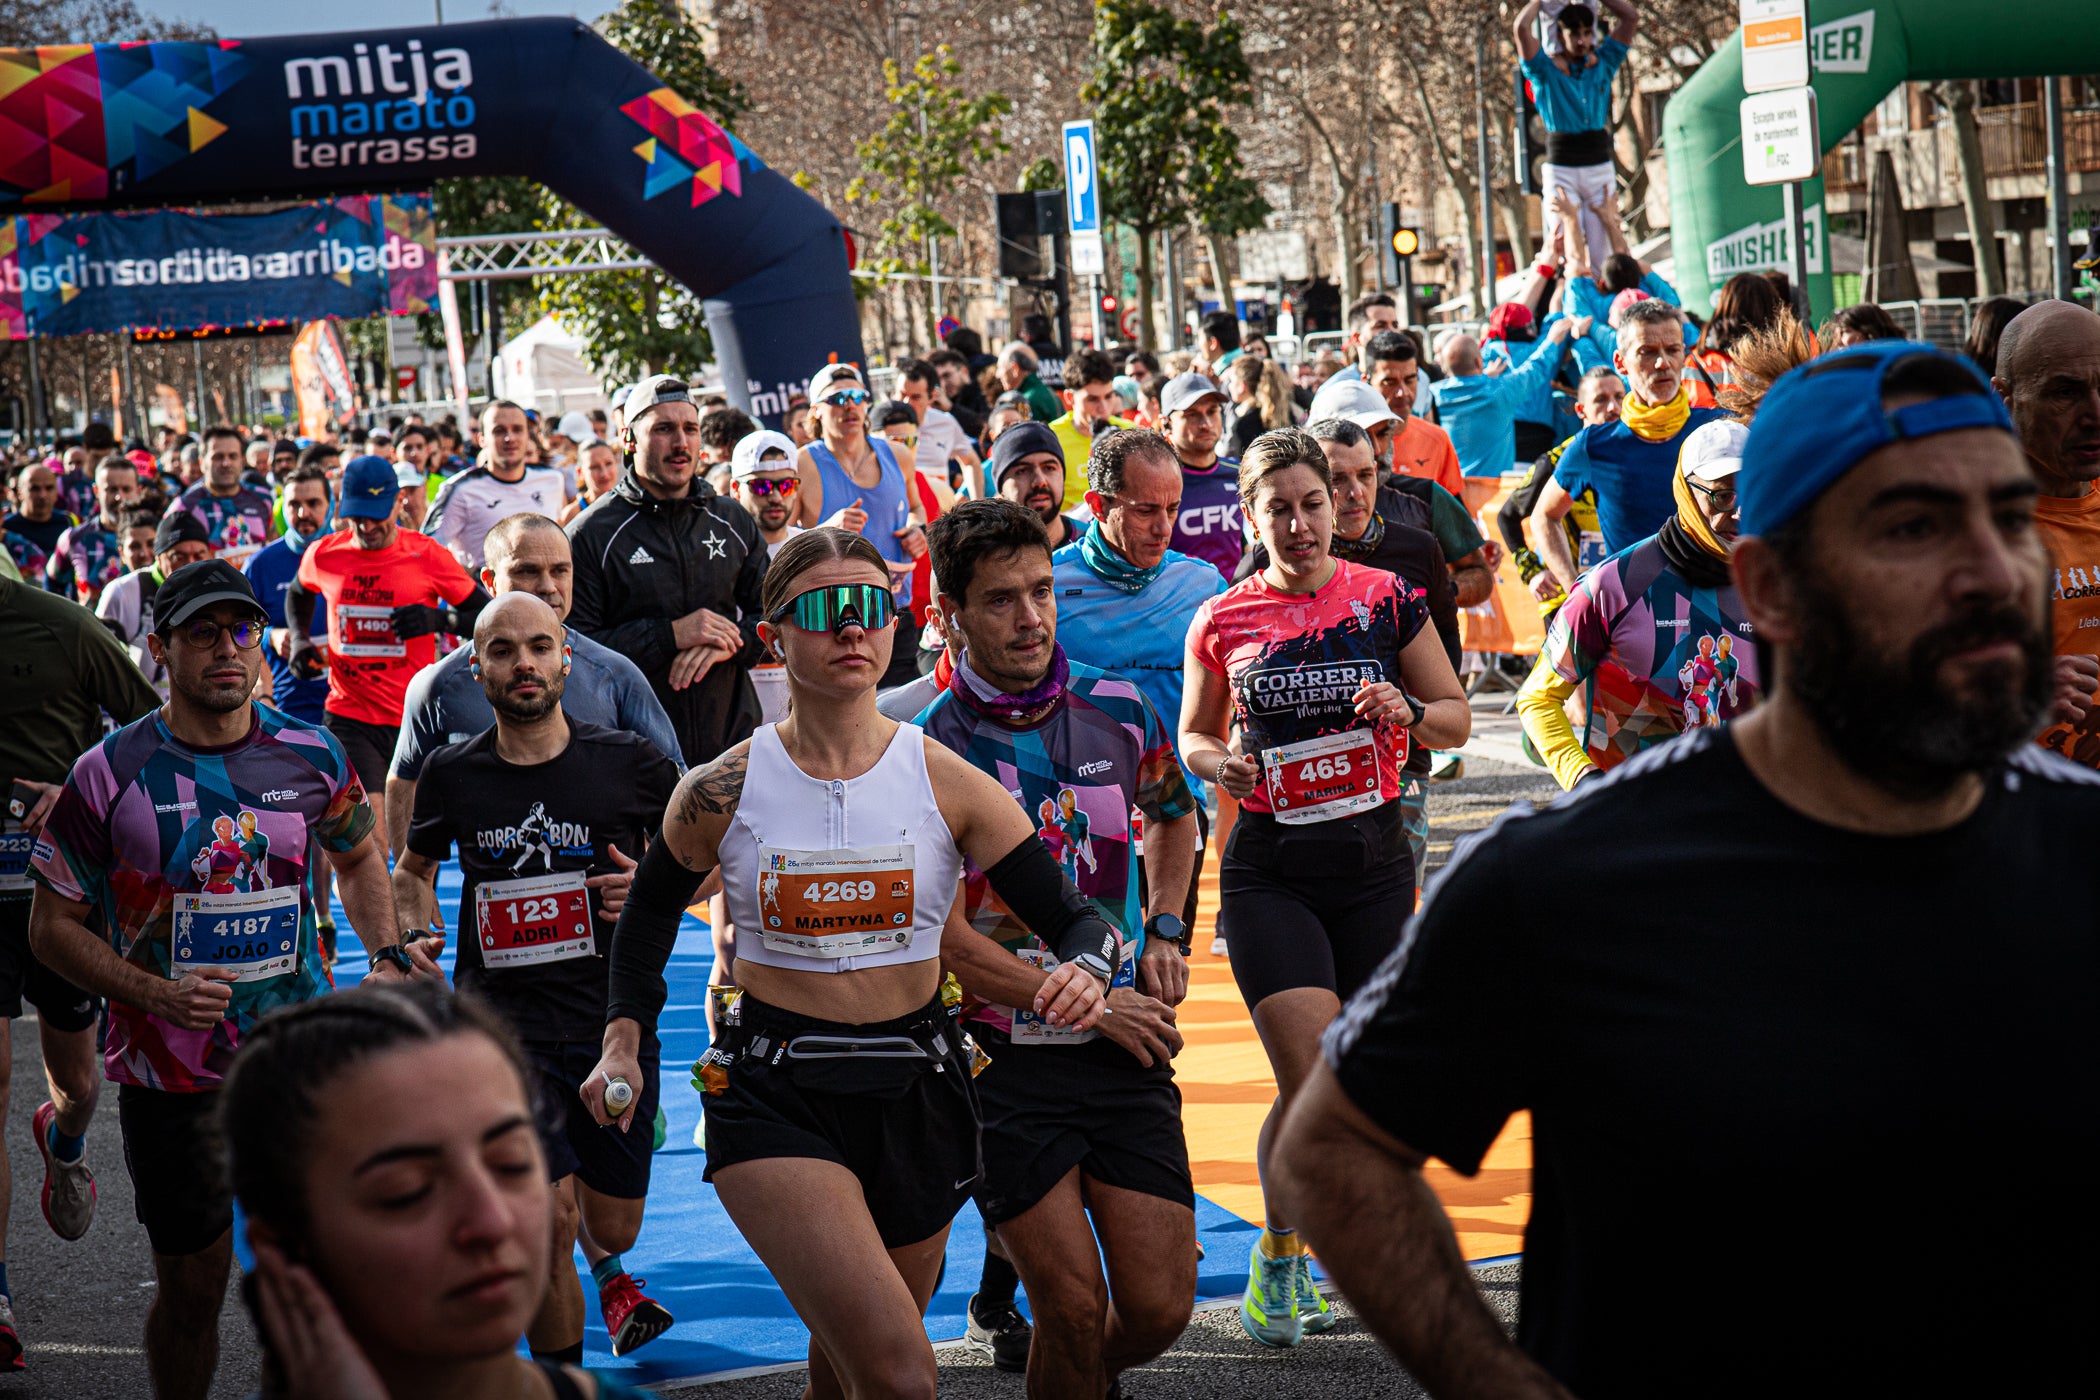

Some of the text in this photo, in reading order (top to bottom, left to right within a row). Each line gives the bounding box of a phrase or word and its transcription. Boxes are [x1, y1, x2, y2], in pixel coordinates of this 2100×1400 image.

[284, 39, 473, 106] mitja
[290, 85, 476, 137] marató
[292, 133, 477, 169] terrassa
[1068, 136, 1090, 222] P
[265, 235, 424, 281] arribada
[1179, 504, 1240, 536] CFK
[356, 620, 389, 632] 1490
[1254, 667, 1358, 693] CORRER
[1361, 666, 1374, 674] ES
[1362, 674, 1376, 682] DE
[1296, 703, 1342, 718] Marina
[1300, 754, 1352, 782] 465
[1304, 782, 1356, 800] MARINA
[478, 822, 589, 850] CORRE BDN
[803, 880, 876, 902] 4269
[506, 898, 559, 924] 123
[796, 914, 884, 930] MARTYNA
[214, 916, 271, 936] 4187
[512, 925, 558, 944] ADRI
[212, 940, 269, 960] JOÃO
